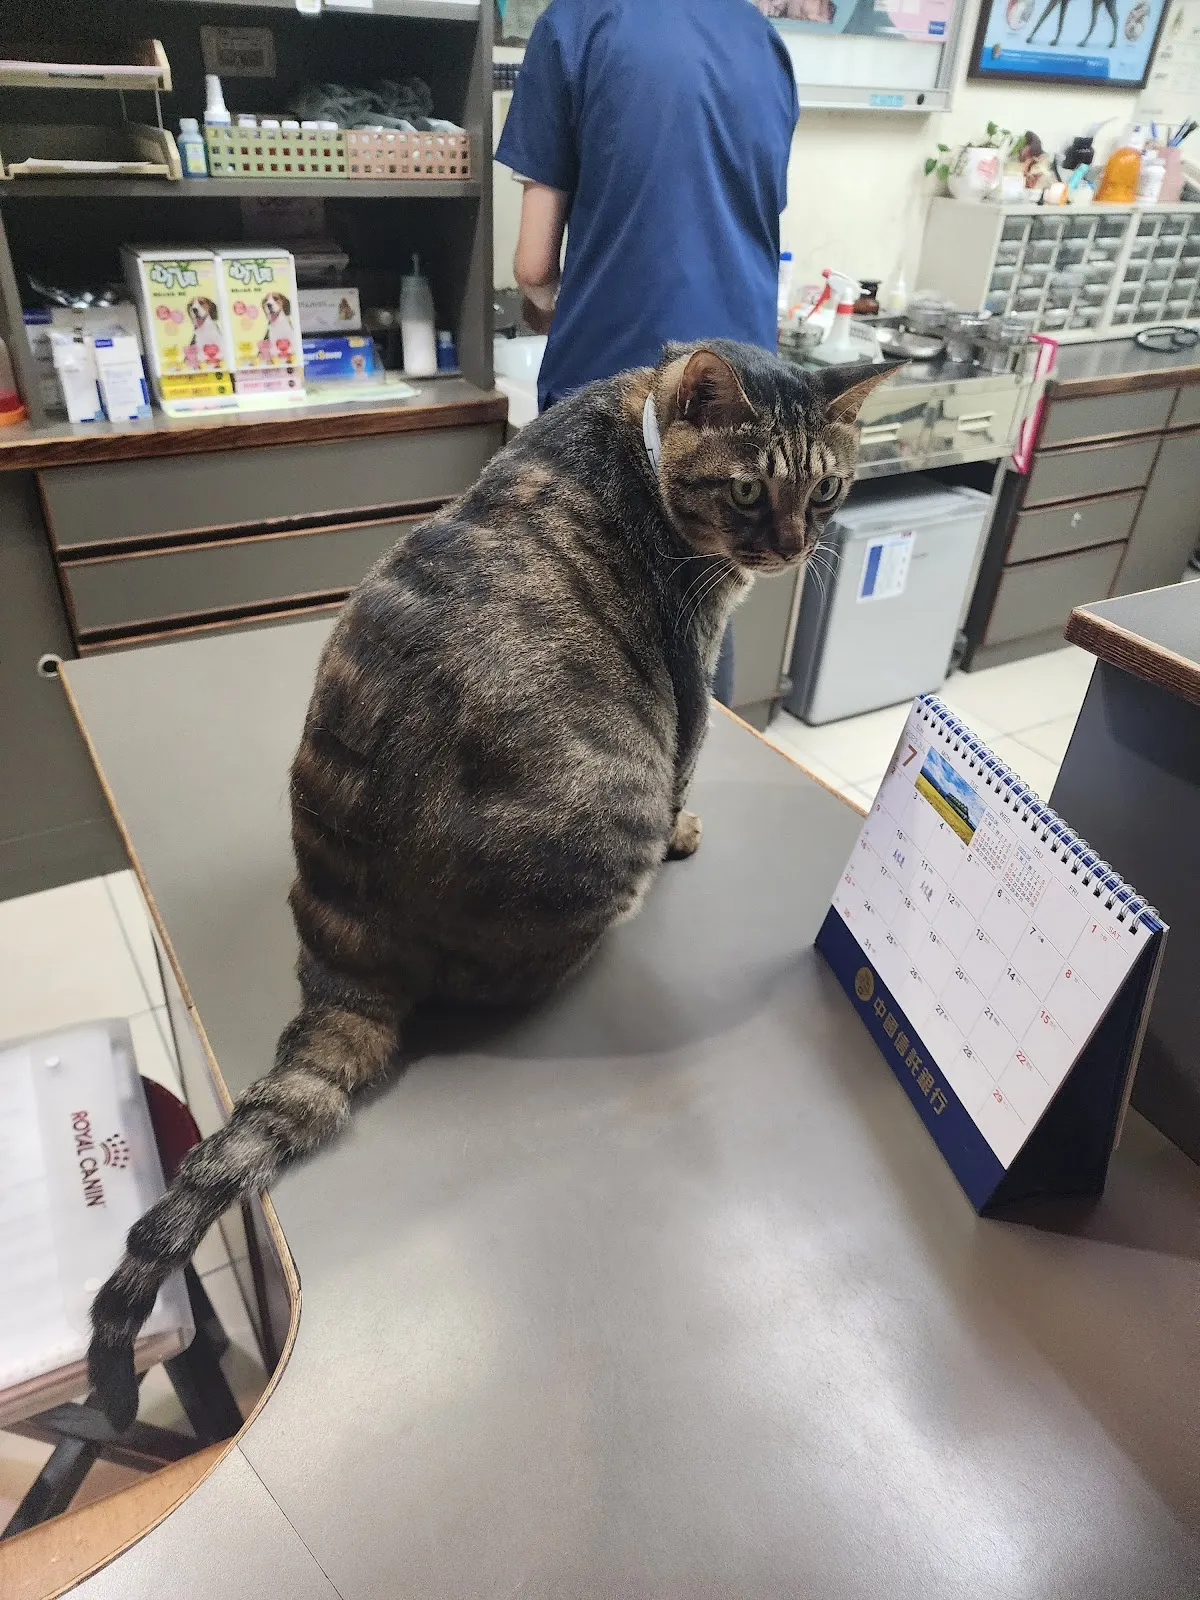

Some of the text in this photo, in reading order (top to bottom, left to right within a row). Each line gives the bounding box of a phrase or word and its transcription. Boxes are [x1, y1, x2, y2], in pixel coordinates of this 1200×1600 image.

[902, 744, 918, 767] 7
[941, 750, 951, 762] MON
[970, 780, 980, 791] TUE
[1000, 811, 1012, 824] WED
[1033, 846, 1044, 859] THU
[1068, 885, 1079, 897] FRI
[1108, 926, 1121, 940] SAT
[864, 901, 871, 911] 24
[935, 1004, 945, 1016] 27
[963, 1045, 972, 1058] 28
[993, 1089, 1003, 1103] 29
[881, 866, 888, 876] 17
[929, 931, 936, 942] 19
[955, 967, 964, 980] 20
[984, 1007, 994, 1020] 21
[1016, 1050, 1026, 1065] 22
[897, 829, 903, 840] 10
[921, 860, 928, 870] 11
[947, 893, 955, 905] 12
[976, 929, 984, 941] 13
[1007, 968, 1016, 980] 14
[1040, 1010, 1050, 1024] 15
[71, 1110, 105, 1208] ROYAL CANIN
